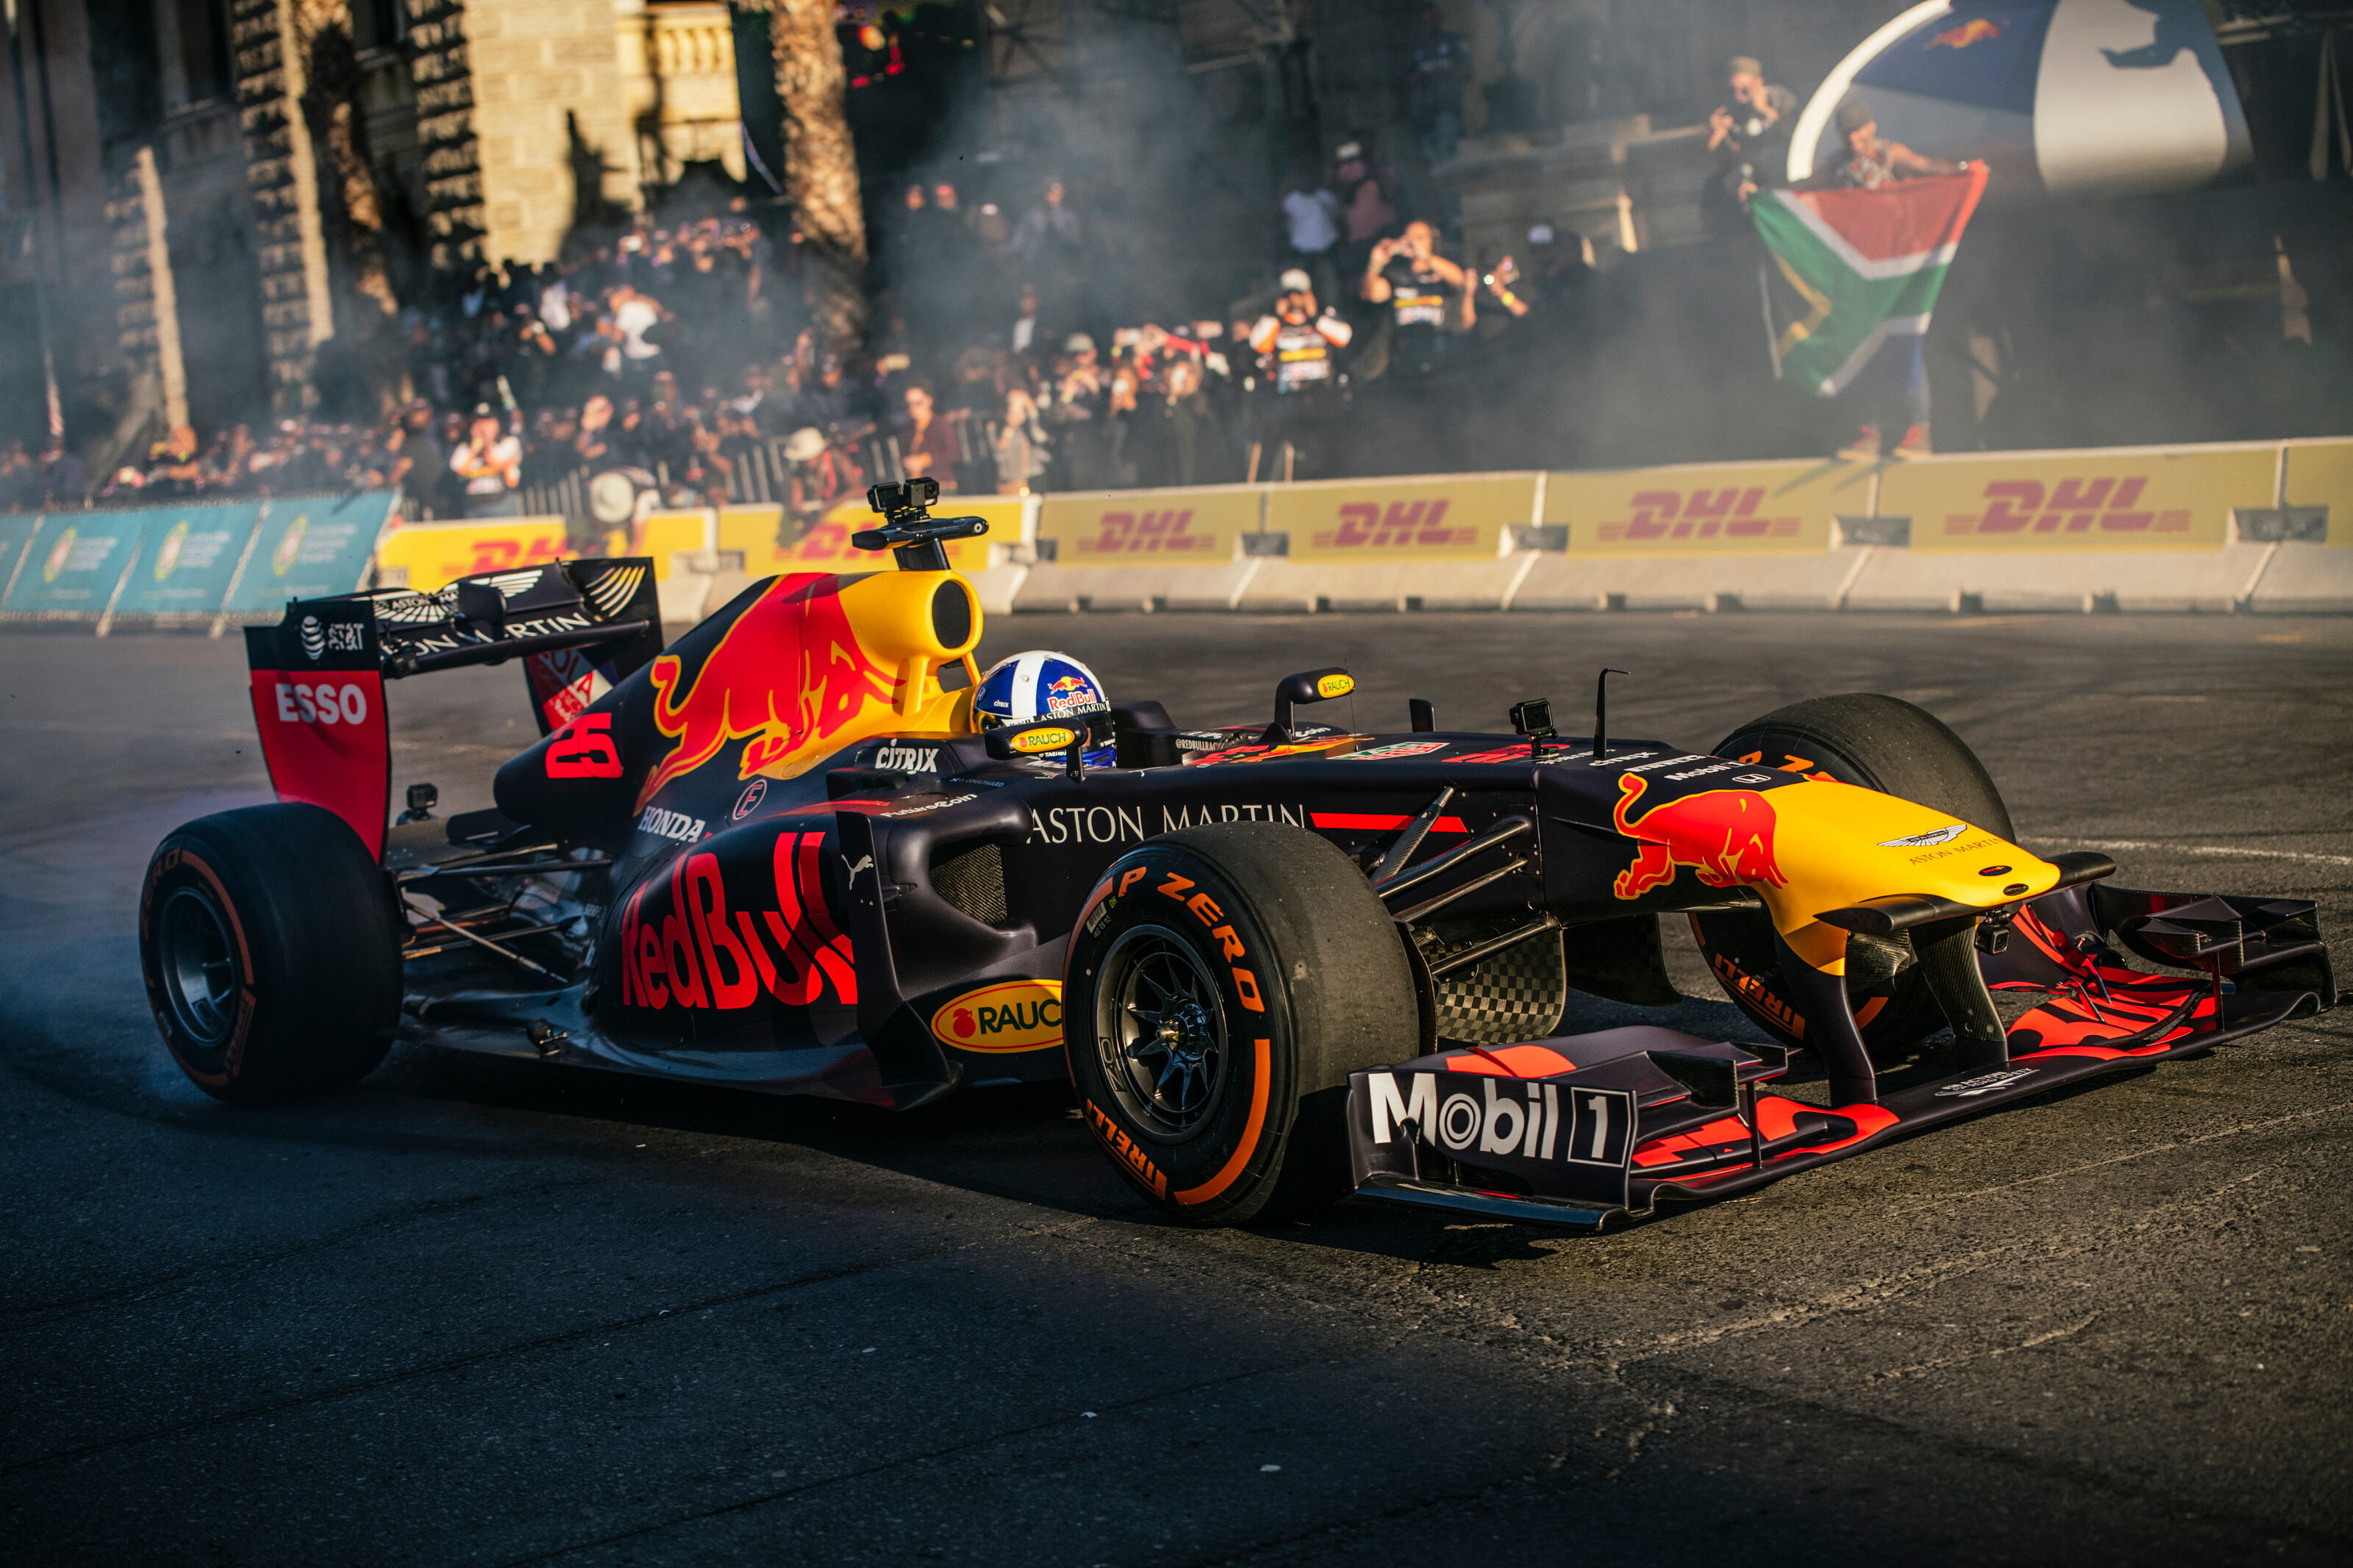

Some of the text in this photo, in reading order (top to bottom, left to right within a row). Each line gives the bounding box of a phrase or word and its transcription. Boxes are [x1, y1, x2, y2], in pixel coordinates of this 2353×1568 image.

[1334, 499, 1455, 546] DHL
[1624, 486, 1770, 540] DHL
[1977, 476, 2155, 534] DHL
[1096, 509, 1196, 553] DHL
[391, 597, 431, 609] ASTON
[328, 623, 364, 651] AT&T
[275, 683, 367, 725] ESSO
[1048, 689, 1096, 712] Red Bull
[1327, 679, 1350, 692] RAUCH
[1040, 701, 1106, 721] ASTON MARTIN
[545, 712, 623, 778] 25
[1029, 732, 1066, 746] RAUCH
[1664, 764, 1732, 781] Mobil
[638, 806, 706, 842] HONDA
[1026, 806, 1144, 845] ASTON
[1910, 837, 2003, 865] ASTON MARTIN
[1118, 866, 1265, 1013] P ZERO
[978, 998, 1062, 1035] RAUC
[1368, 1072, 1607, 1160] Mobil 1
[1086, 1098, 1168, 1201] PIRELLI
